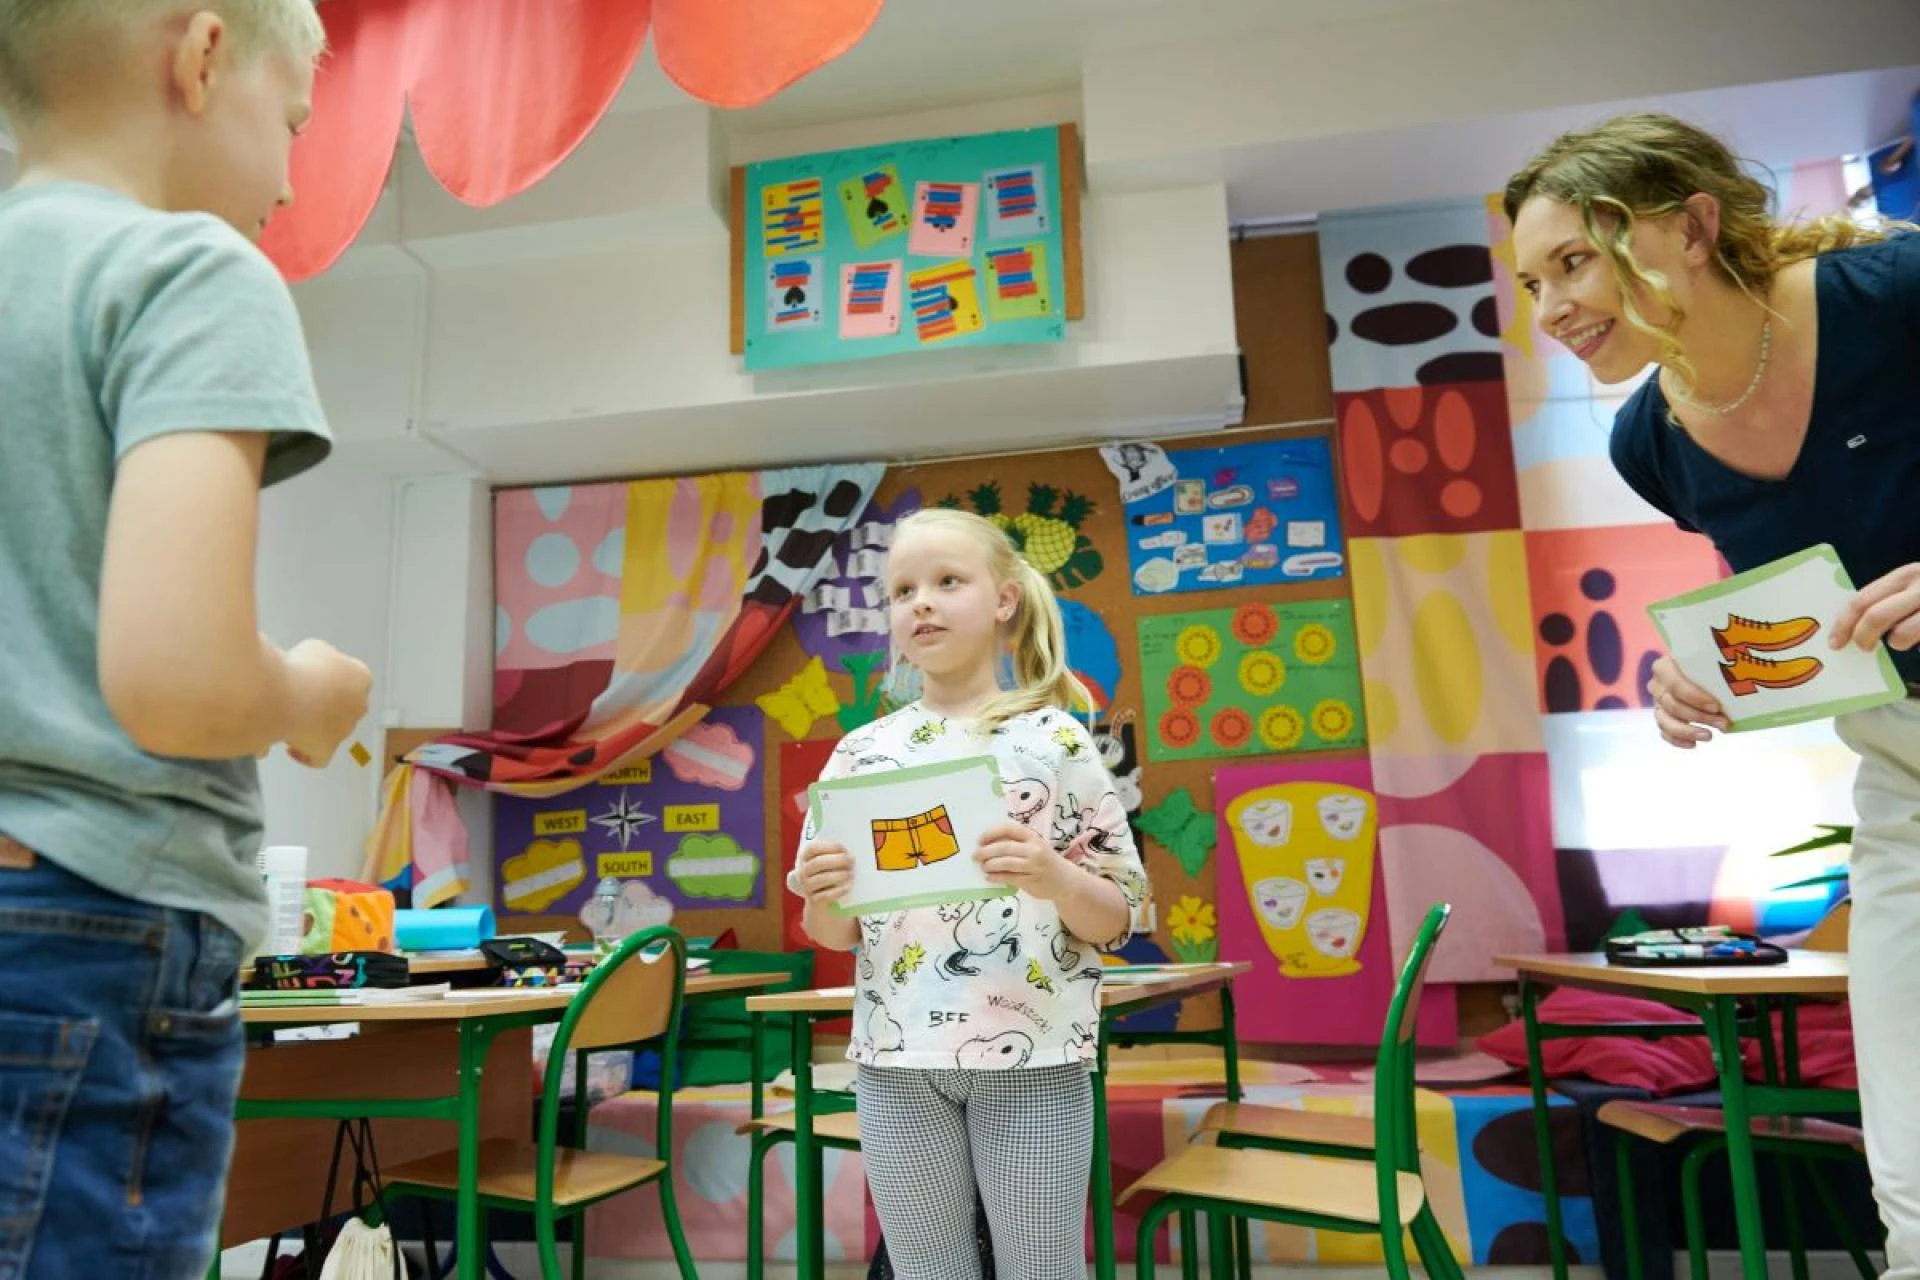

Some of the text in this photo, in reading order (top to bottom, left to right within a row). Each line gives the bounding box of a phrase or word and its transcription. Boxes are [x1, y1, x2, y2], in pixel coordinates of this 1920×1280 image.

[543, 815, 580, 830] WEST
[676, 812, 707, 825] EAST
[603, 860, 647, 873] SOUTH
[928, 1010, 970, 1028] BFF
